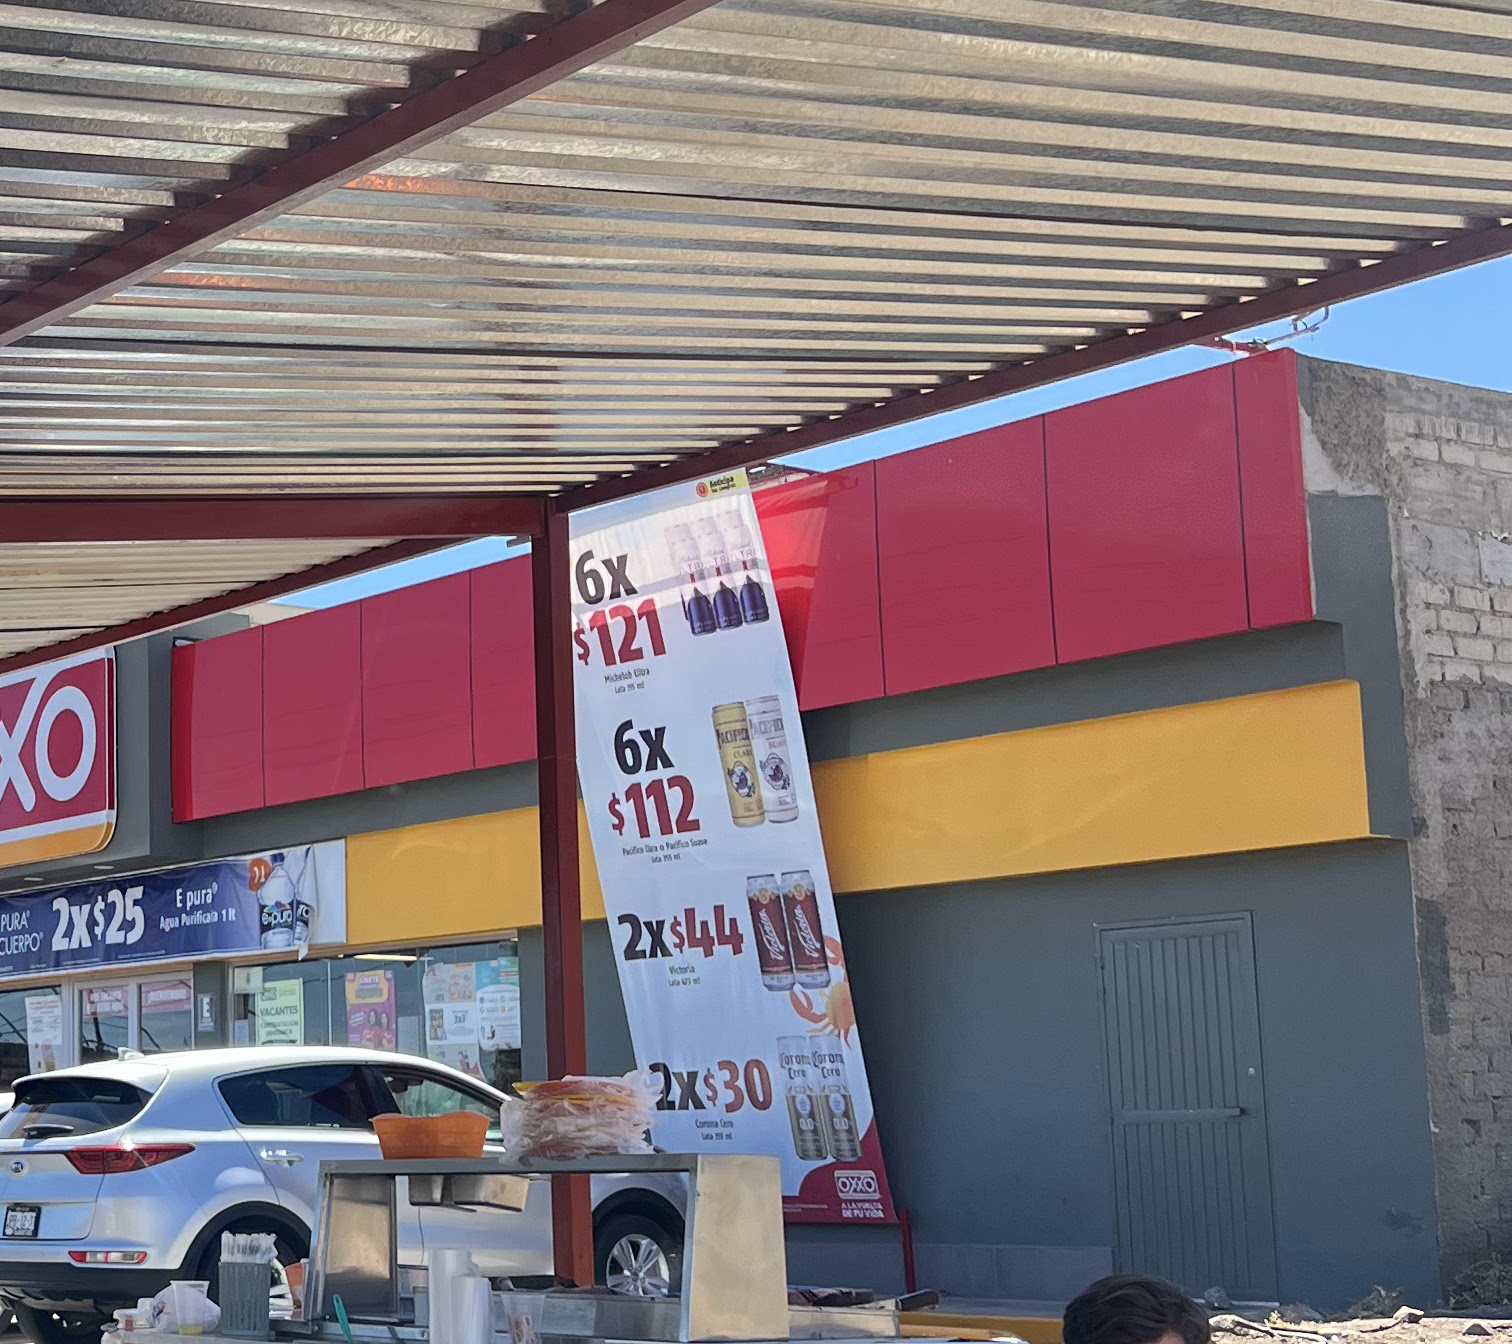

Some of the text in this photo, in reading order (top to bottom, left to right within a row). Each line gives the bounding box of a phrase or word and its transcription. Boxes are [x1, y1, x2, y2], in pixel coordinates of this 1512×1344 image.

[575, 549, 638, 605] 6x
[573, 597, 667, 668] $121
[613, 718, 675, 776] 6x
[608, 774, 701, 839] $112
[175, 888, 183, 908] E
[160, 915, 180, 932] Agua
[221, 908, 228, 922] 1
[668, 964, 695, 975] Victoria
[259, 1005, 298, 1017] VACANTES
[838, 1176, 875, 1194] OXXO
